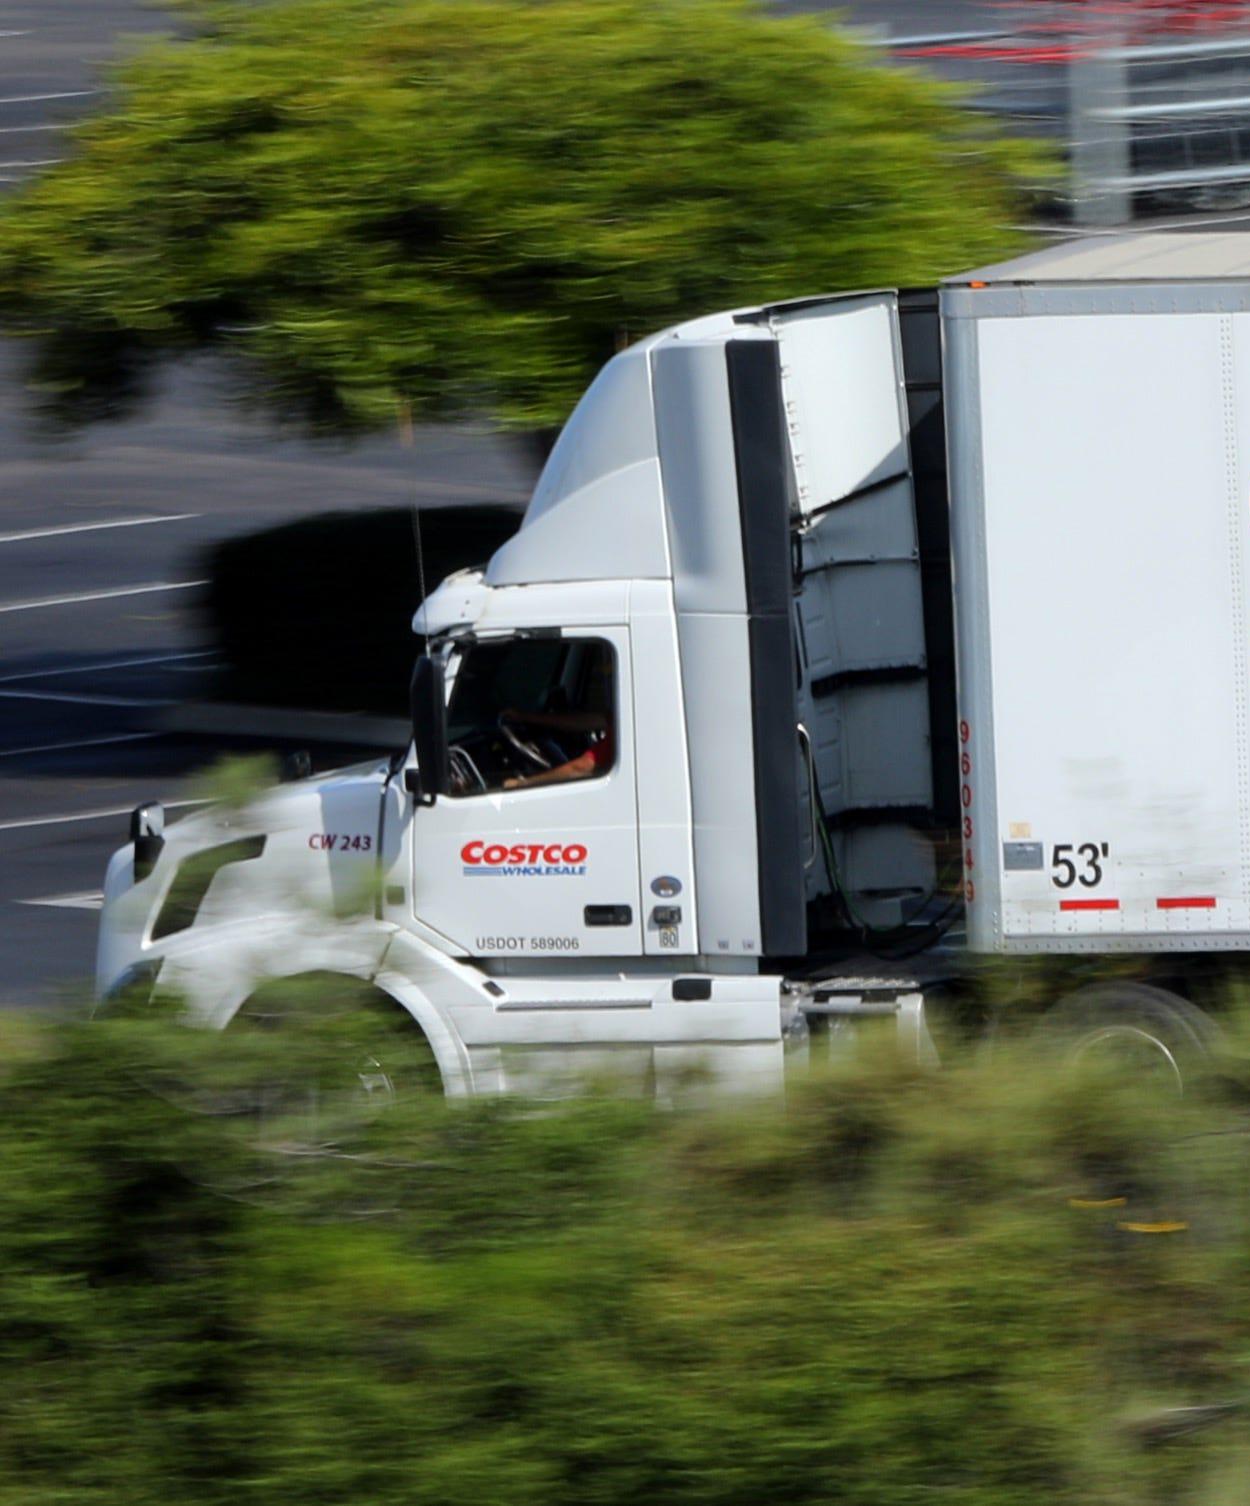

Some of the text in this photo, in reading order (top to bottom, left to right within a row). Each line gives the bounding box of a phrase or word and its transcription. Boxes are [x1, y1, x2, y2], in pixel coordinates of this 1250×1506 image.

[308, 835, 371, 852] CW 243
[460, 840, 588, 865] COSTCO
[502, 866, 586, 876] WHOLESALE
[1052, 842, 1109, 888] 53'
[475, 937, 580, 950] USDOT 589006
